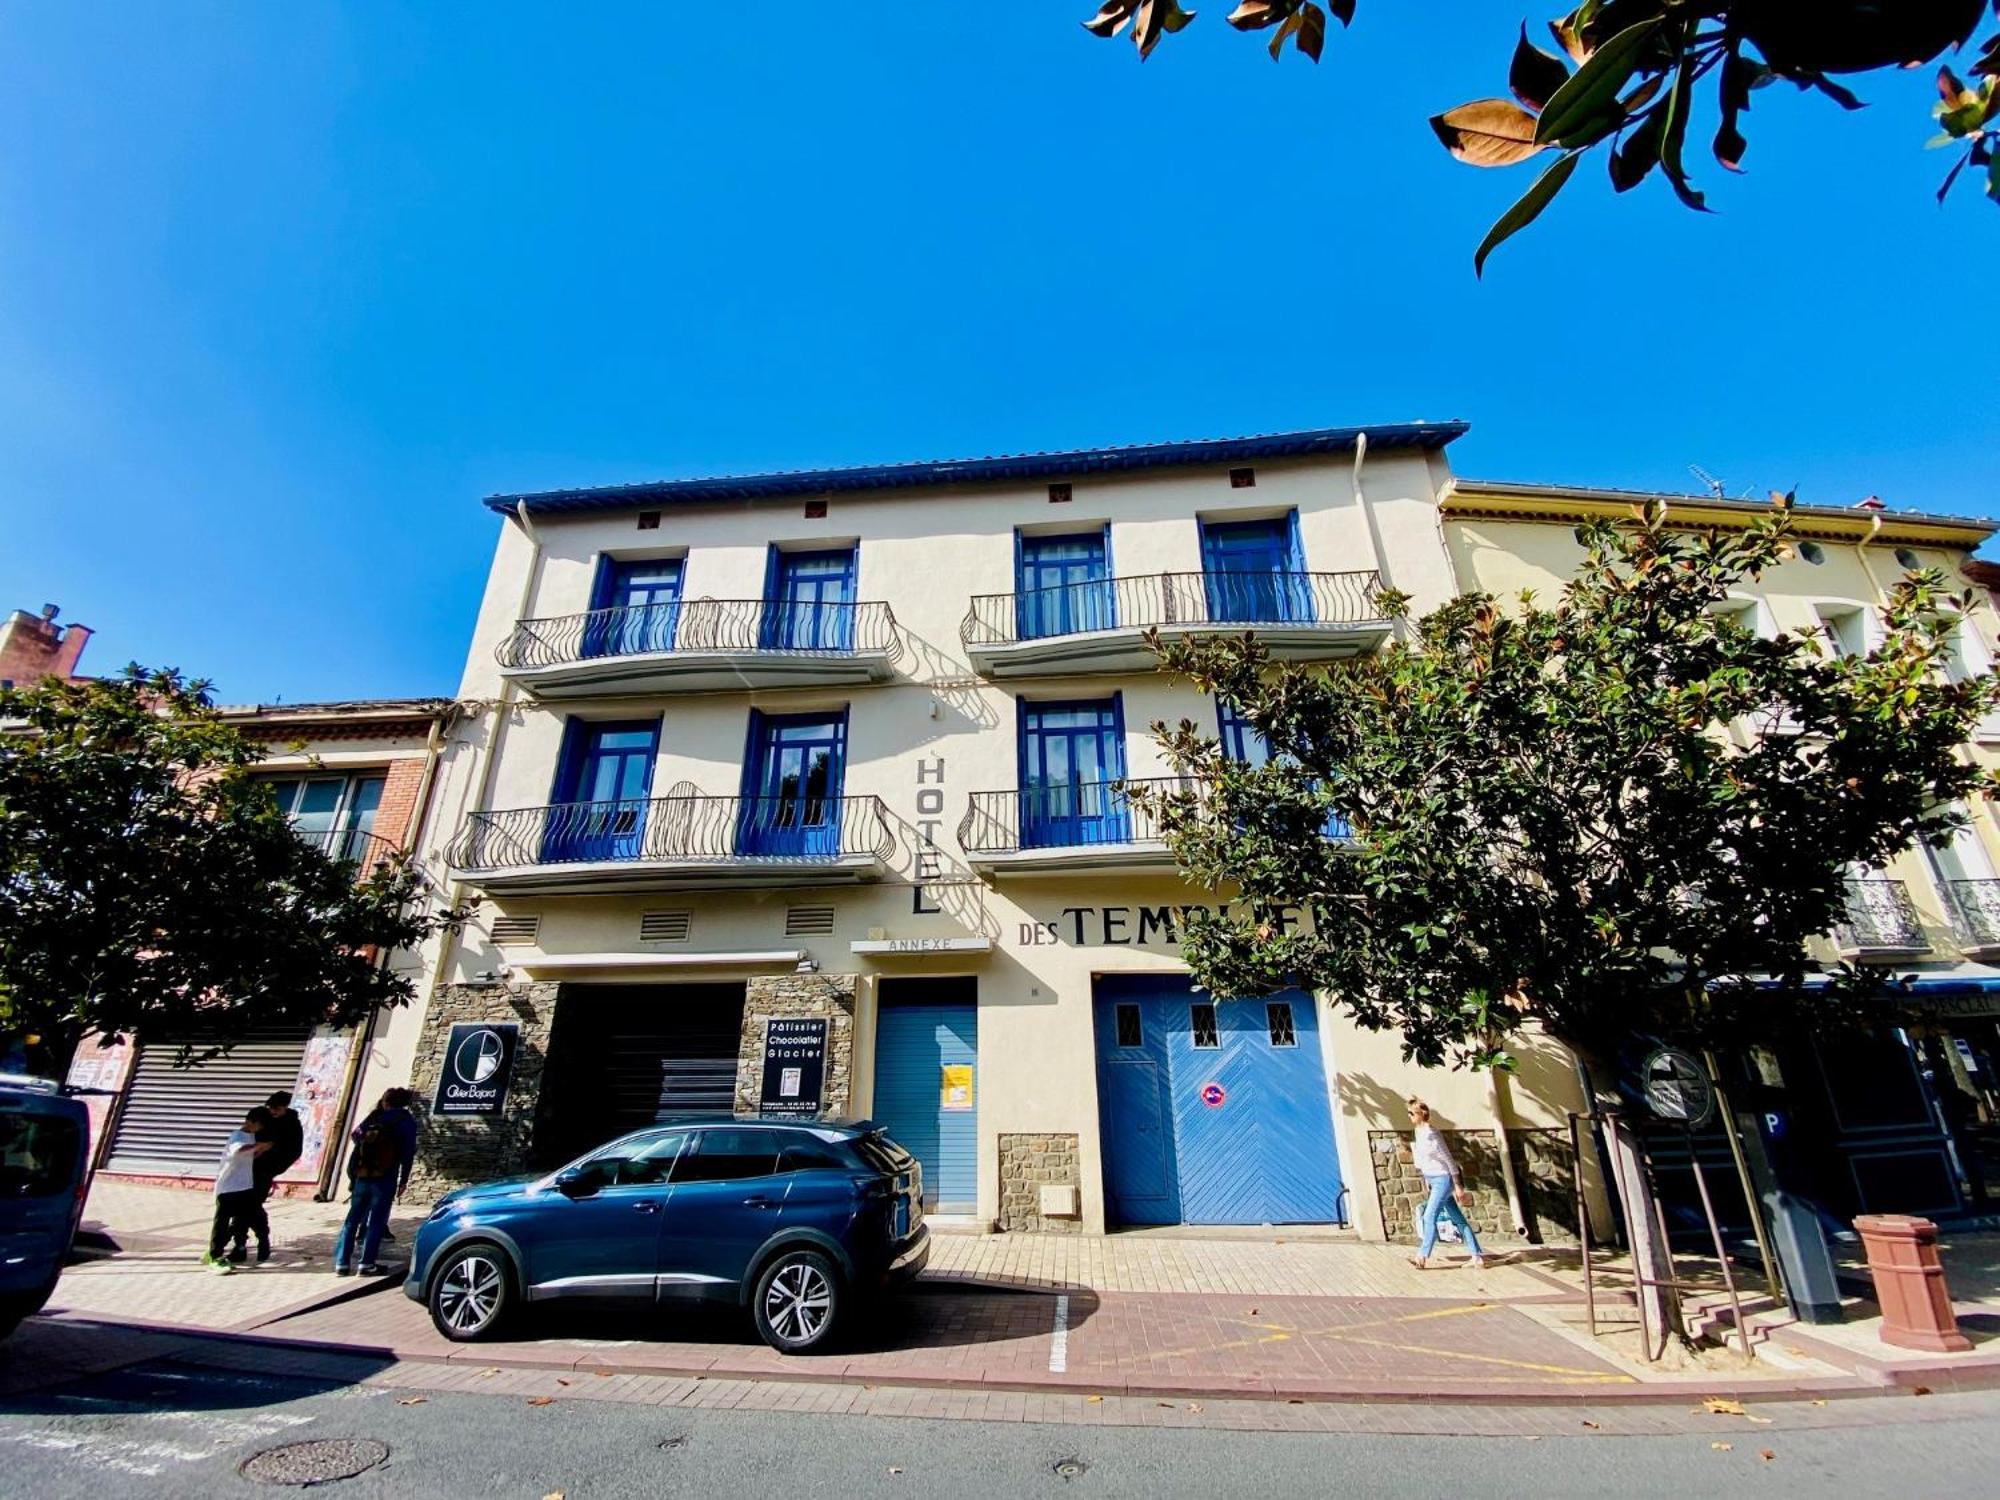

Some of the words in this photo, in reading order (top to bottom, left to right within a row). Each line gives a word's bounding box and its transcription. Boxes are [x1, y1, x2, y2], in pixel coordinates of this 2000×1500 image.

[913, 758, 945, 915] HOTEL
[1018, 921, 1059, 946] DES
[889, 938, 953, 952] ANNEXE
[770, 1022, 823, 1032] Pâtissier
[768, 1035, 822, 1045] Chocolatier
[767, 1048, 821, 1058] Glacier
[1765, 1113, 1779, 1133] P
